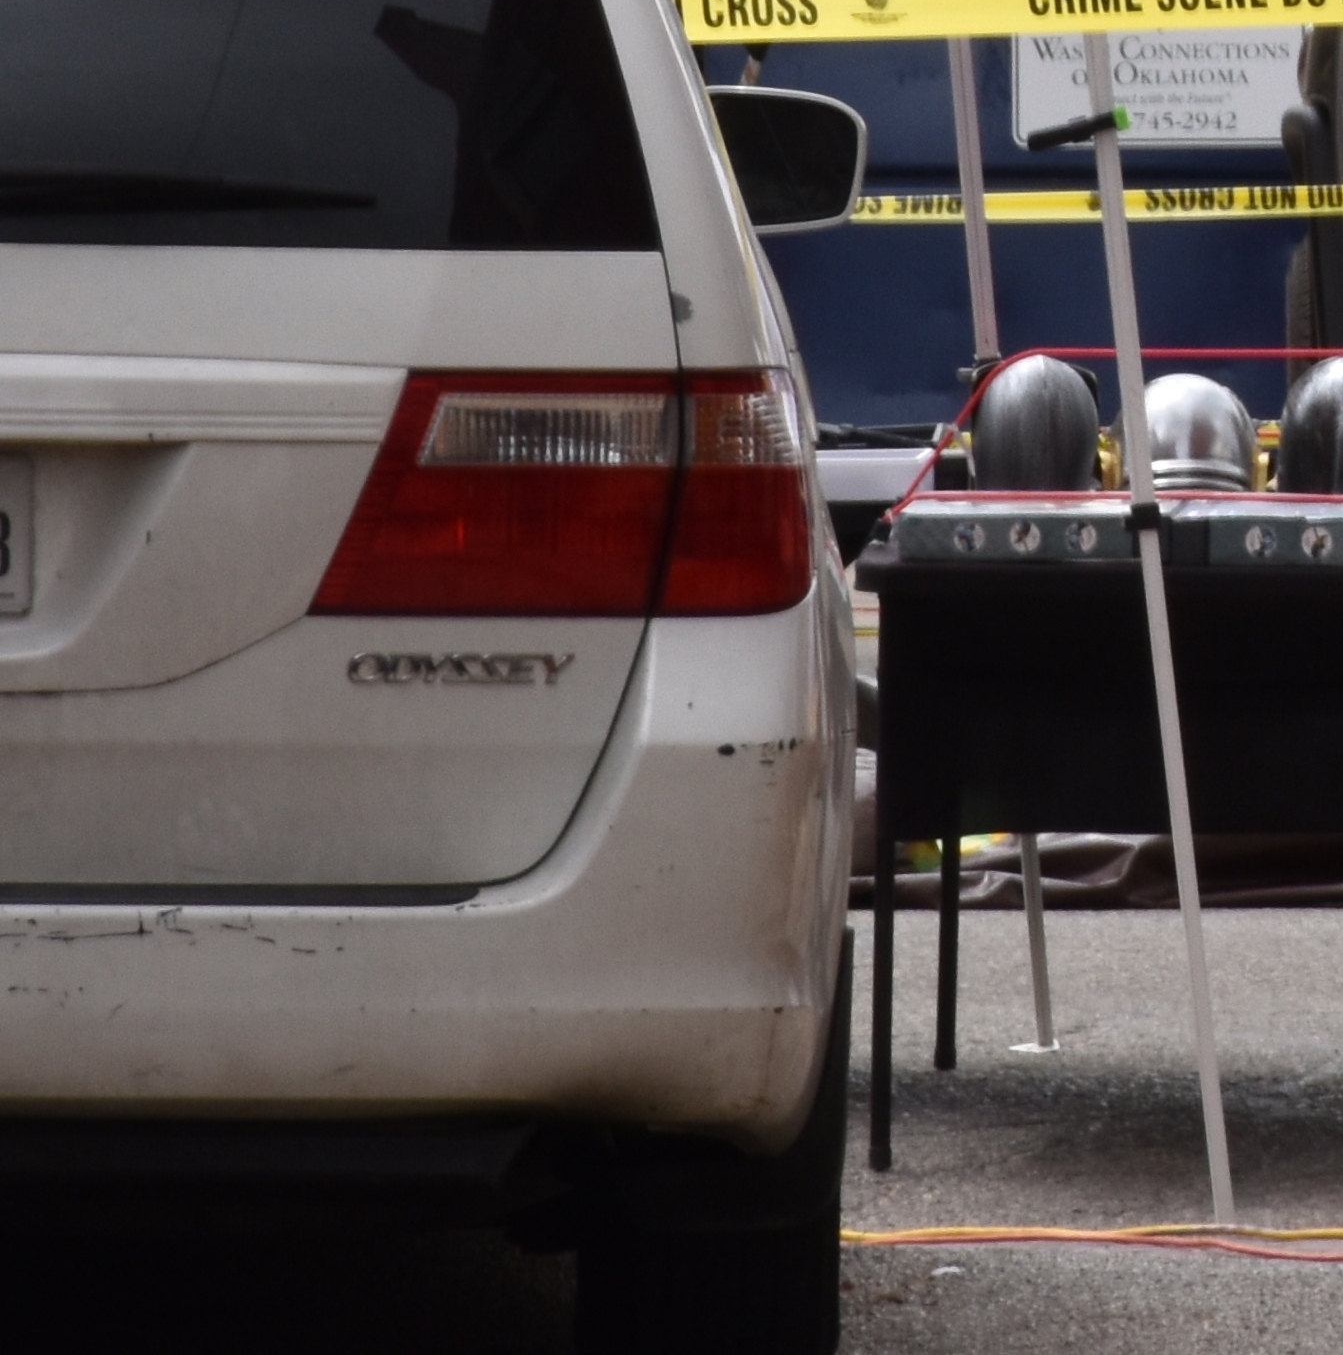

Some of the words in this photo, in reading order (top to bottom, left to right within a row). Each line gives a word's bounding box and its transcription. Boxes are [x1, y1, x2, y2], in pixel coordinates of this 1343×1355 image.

[1030, 36, 1083, 62] WAS
[1119, 35, 1290, 60] CONNECTIONS
[1114, 61, 1249, 86] OKLAHOMA
[1133, 111, 1237, 131] 745-2942
[893, 195, 962, 215] RIME
[1145, 186, 1235, 212] CROSS
[1243, 185, 1297, 211] NOT
[348, 651, 576, 685] ODYSSEY
